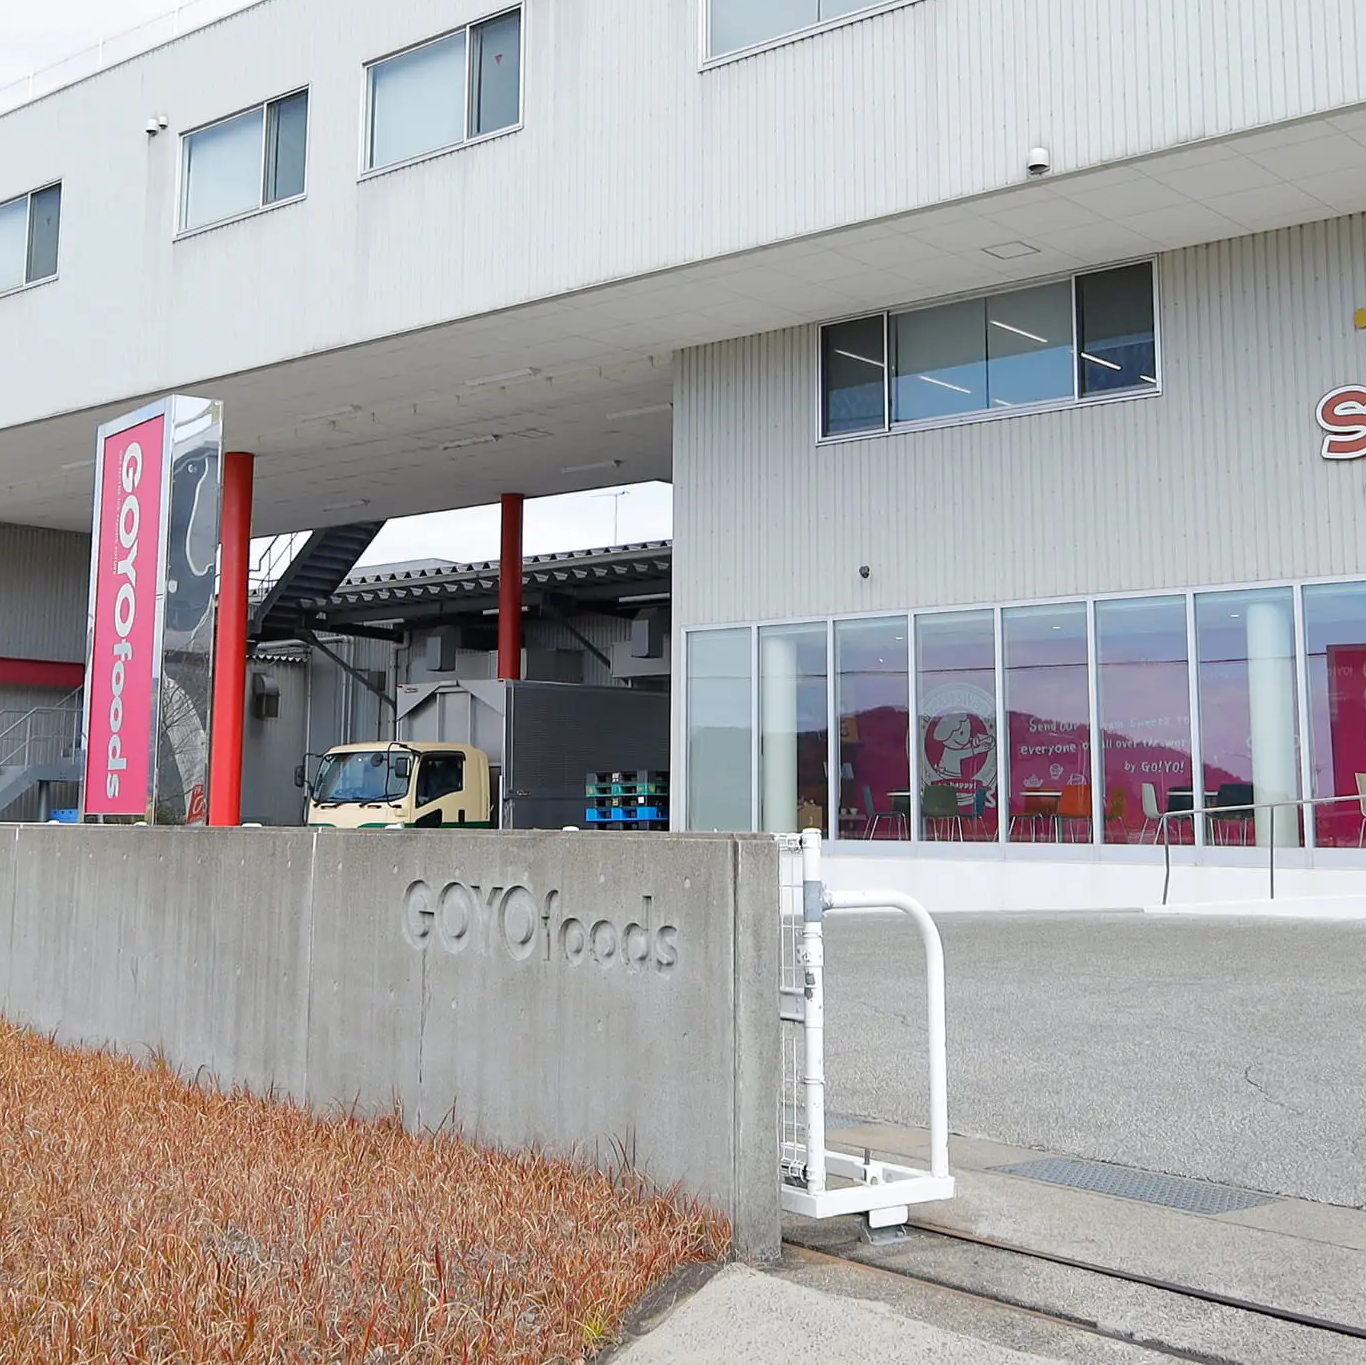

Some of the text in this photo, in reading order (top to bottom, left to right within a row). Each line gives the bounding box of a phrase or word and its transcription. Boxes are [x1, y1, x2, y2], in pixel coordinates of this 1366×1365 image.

[104, 440, 144, 801] GOYOfoods
[1020, 743, 1077, 756] everyone
[1116, 739, 1138, 749] over
[1124, 761, 1136, 773] by
[402, 879, 678, 974] GOYOfoods
